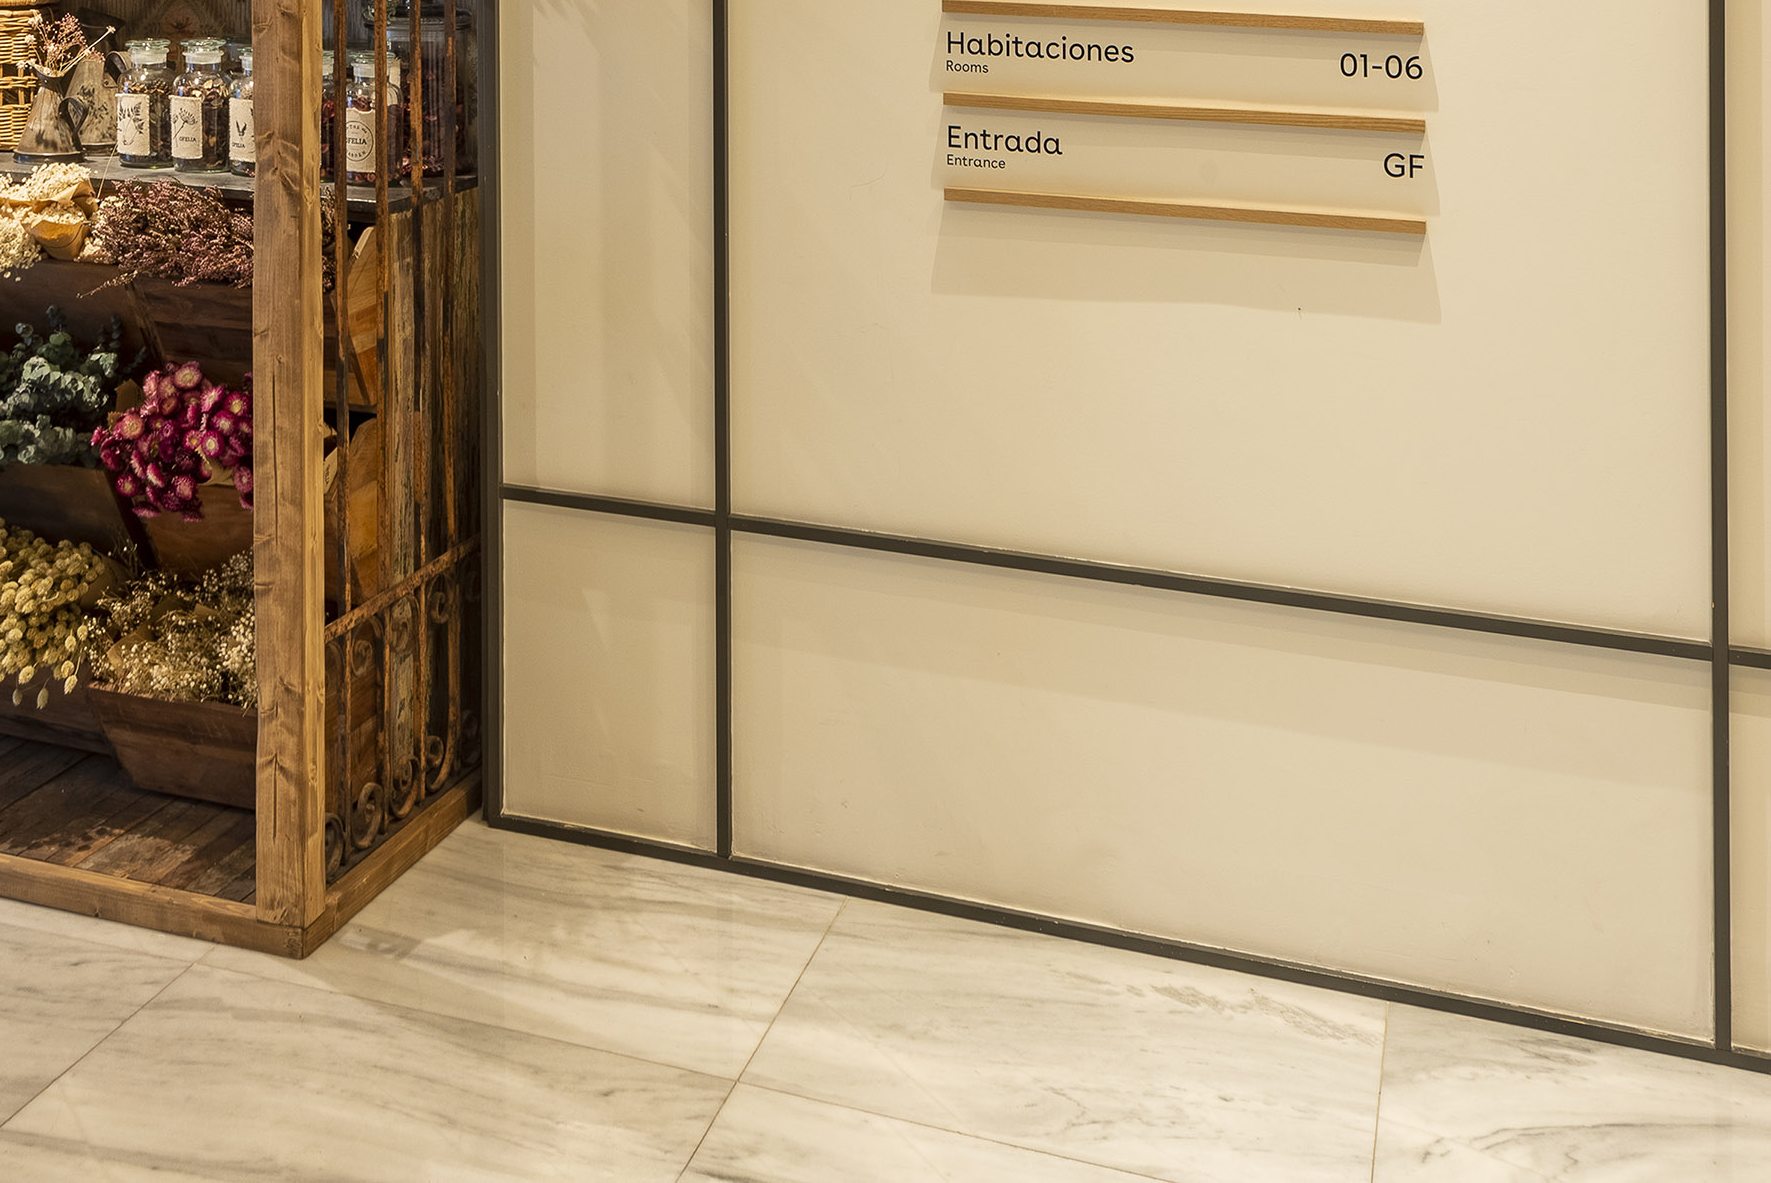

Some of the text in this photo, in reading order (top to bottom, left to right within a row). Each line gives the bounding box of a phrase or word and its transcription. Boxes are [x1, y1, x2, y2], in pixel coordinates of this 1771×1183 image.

[947, 31, 1135, 63] Habitaciones
[946, 59, 989, 74] Rooms
[1340, 53, 1423, 80] 01-06
[346, 137, 368, 145] FELIA
[947, 125, 1063, 155] Entrada
[946, 153, 1006, 170] Entrance
[1383, 152, 1425, 179] GF
